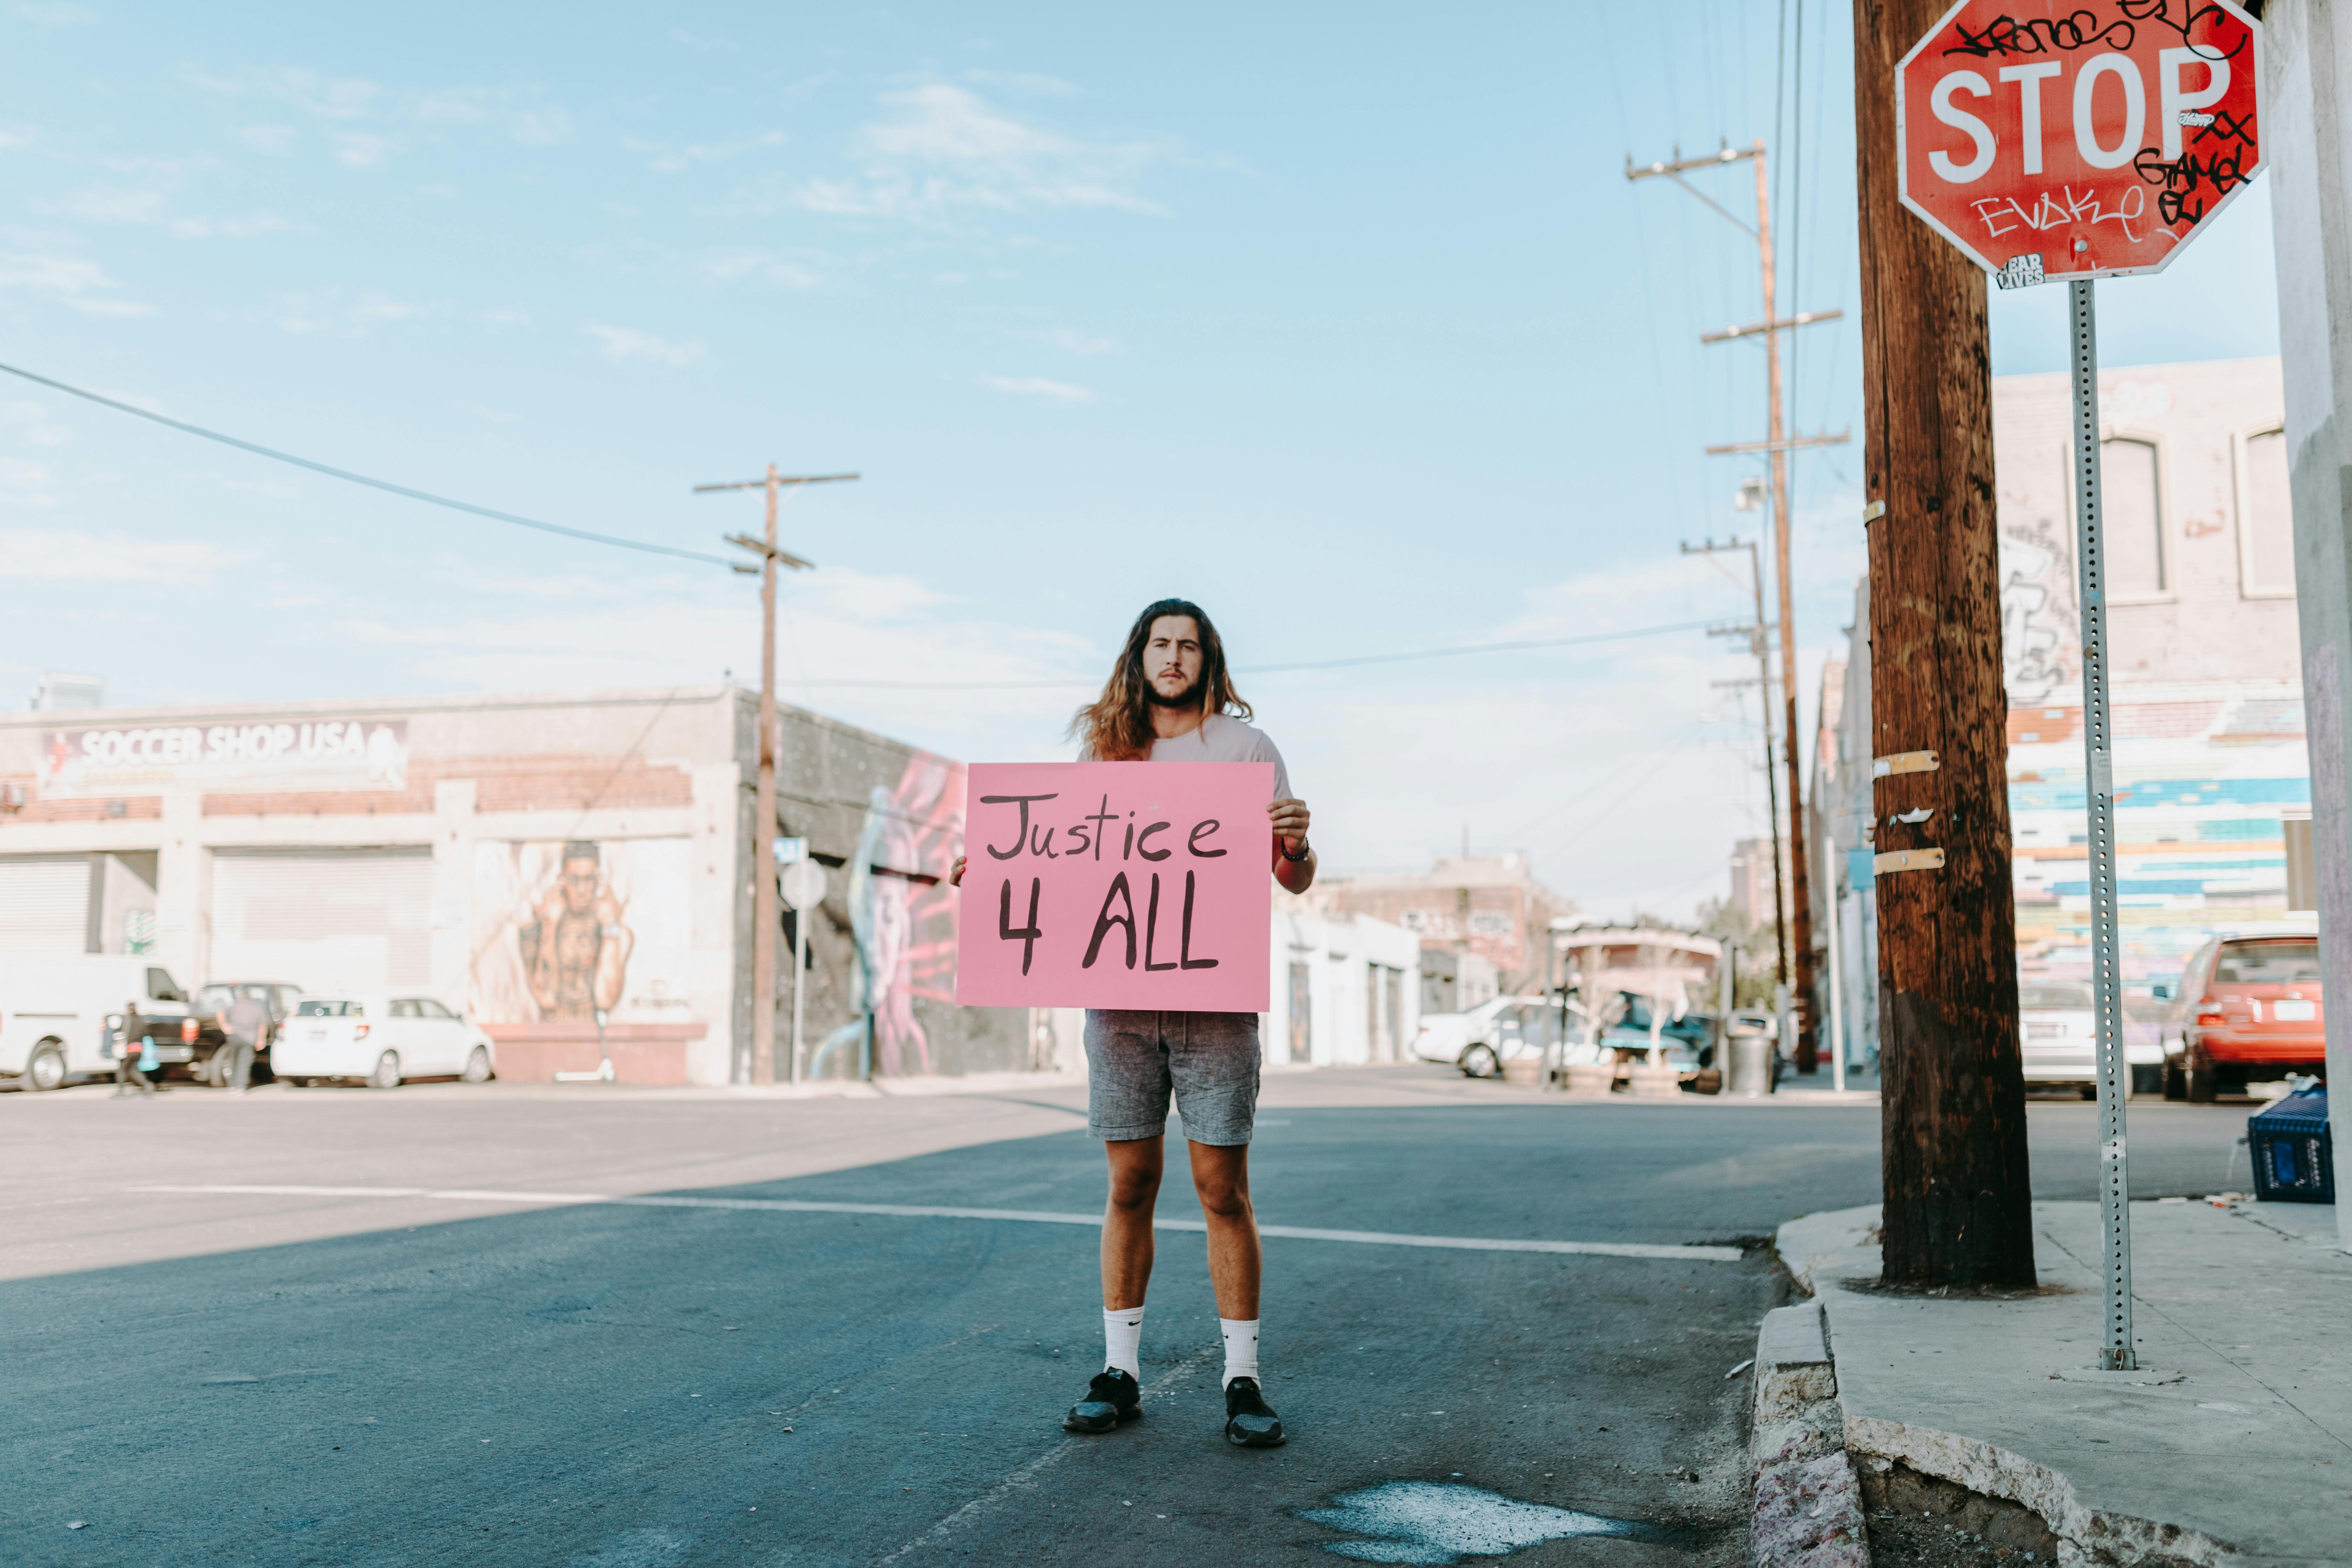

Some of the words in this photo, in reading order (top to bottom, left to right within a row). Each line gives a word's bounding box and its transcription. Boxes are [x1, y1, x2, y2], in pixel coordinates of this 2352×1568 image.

[1929, 44, 2231, 183] STOP
[2178, 113, 2215, 126] Huggy
[1997, 269, 2044, 289] LIVES
[80, 726, 203, 767] SOCCER
[207, 723, 295, 762] SHOP
[299, 721, 364, 760] USA
[980, 793, 1227, 861] Justice
[1000, 877, 1042, 976] 4
[1082, 870, 1219, 972] ALL
